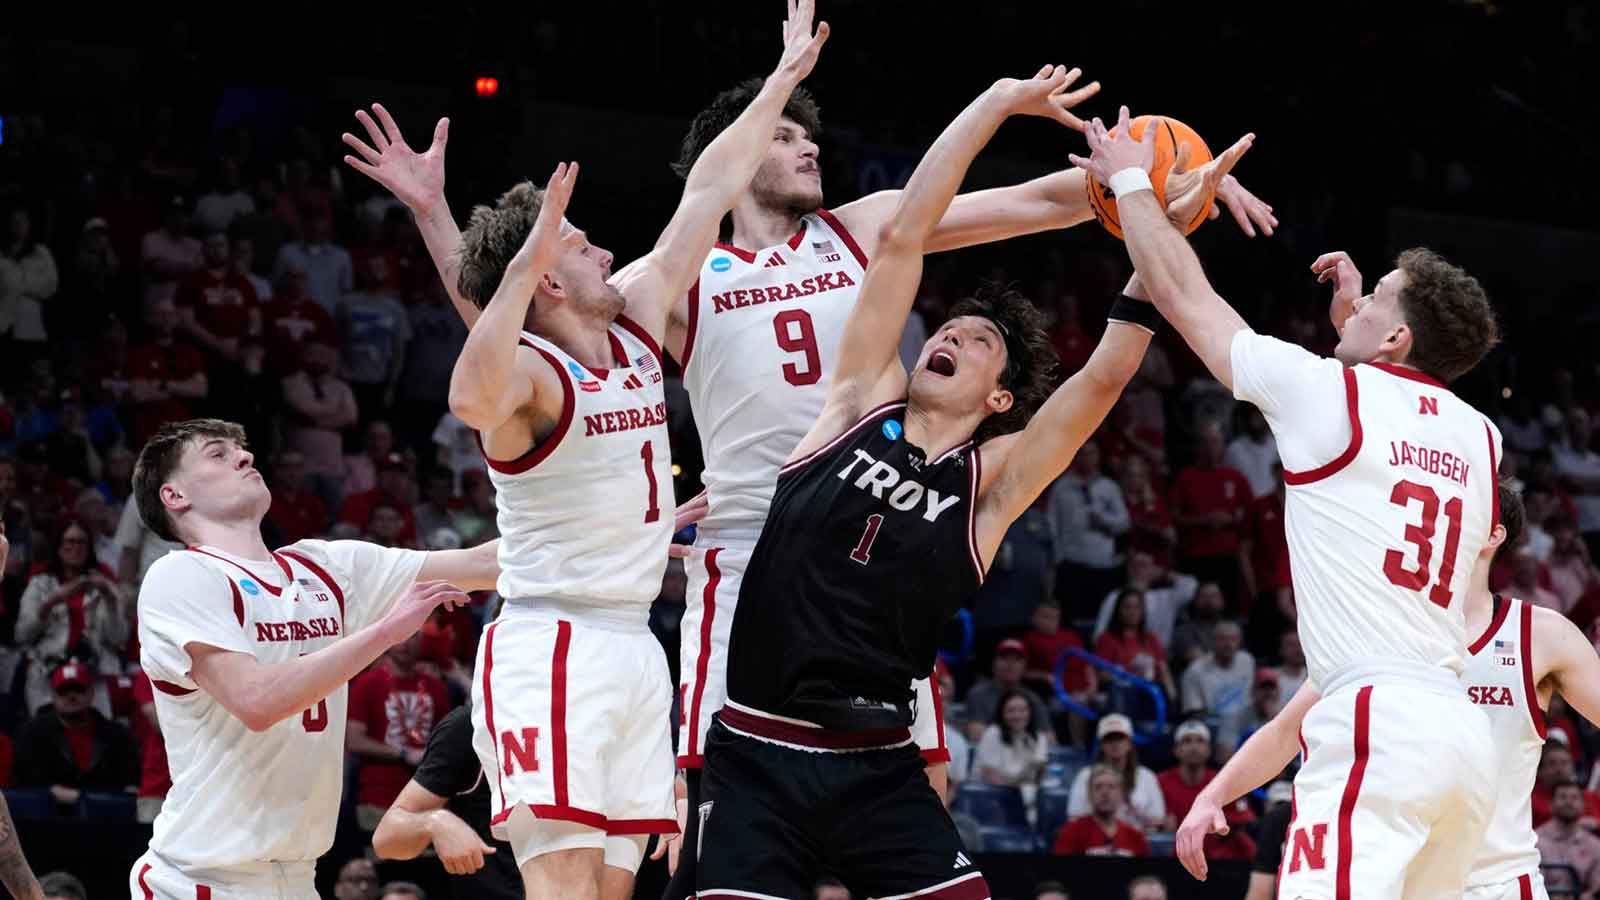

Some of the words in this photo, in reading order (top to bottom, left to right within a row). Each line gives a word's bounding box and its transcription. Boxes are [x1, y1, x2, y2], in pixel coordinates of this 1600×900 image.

[712, 270, 855, 314] NEBRASKA
[773, 308, 822, 387] 9
[1419, 396, 1438, 416] N
[640, 440, 660, 523] 1
[837, 448, 960, 522] TROY
[850, 513, 884, 565] 1
[1383, 479, 1463, 609] 31
[501, 727, 539, 777] N
[1289, 823, 1328, 874] N
